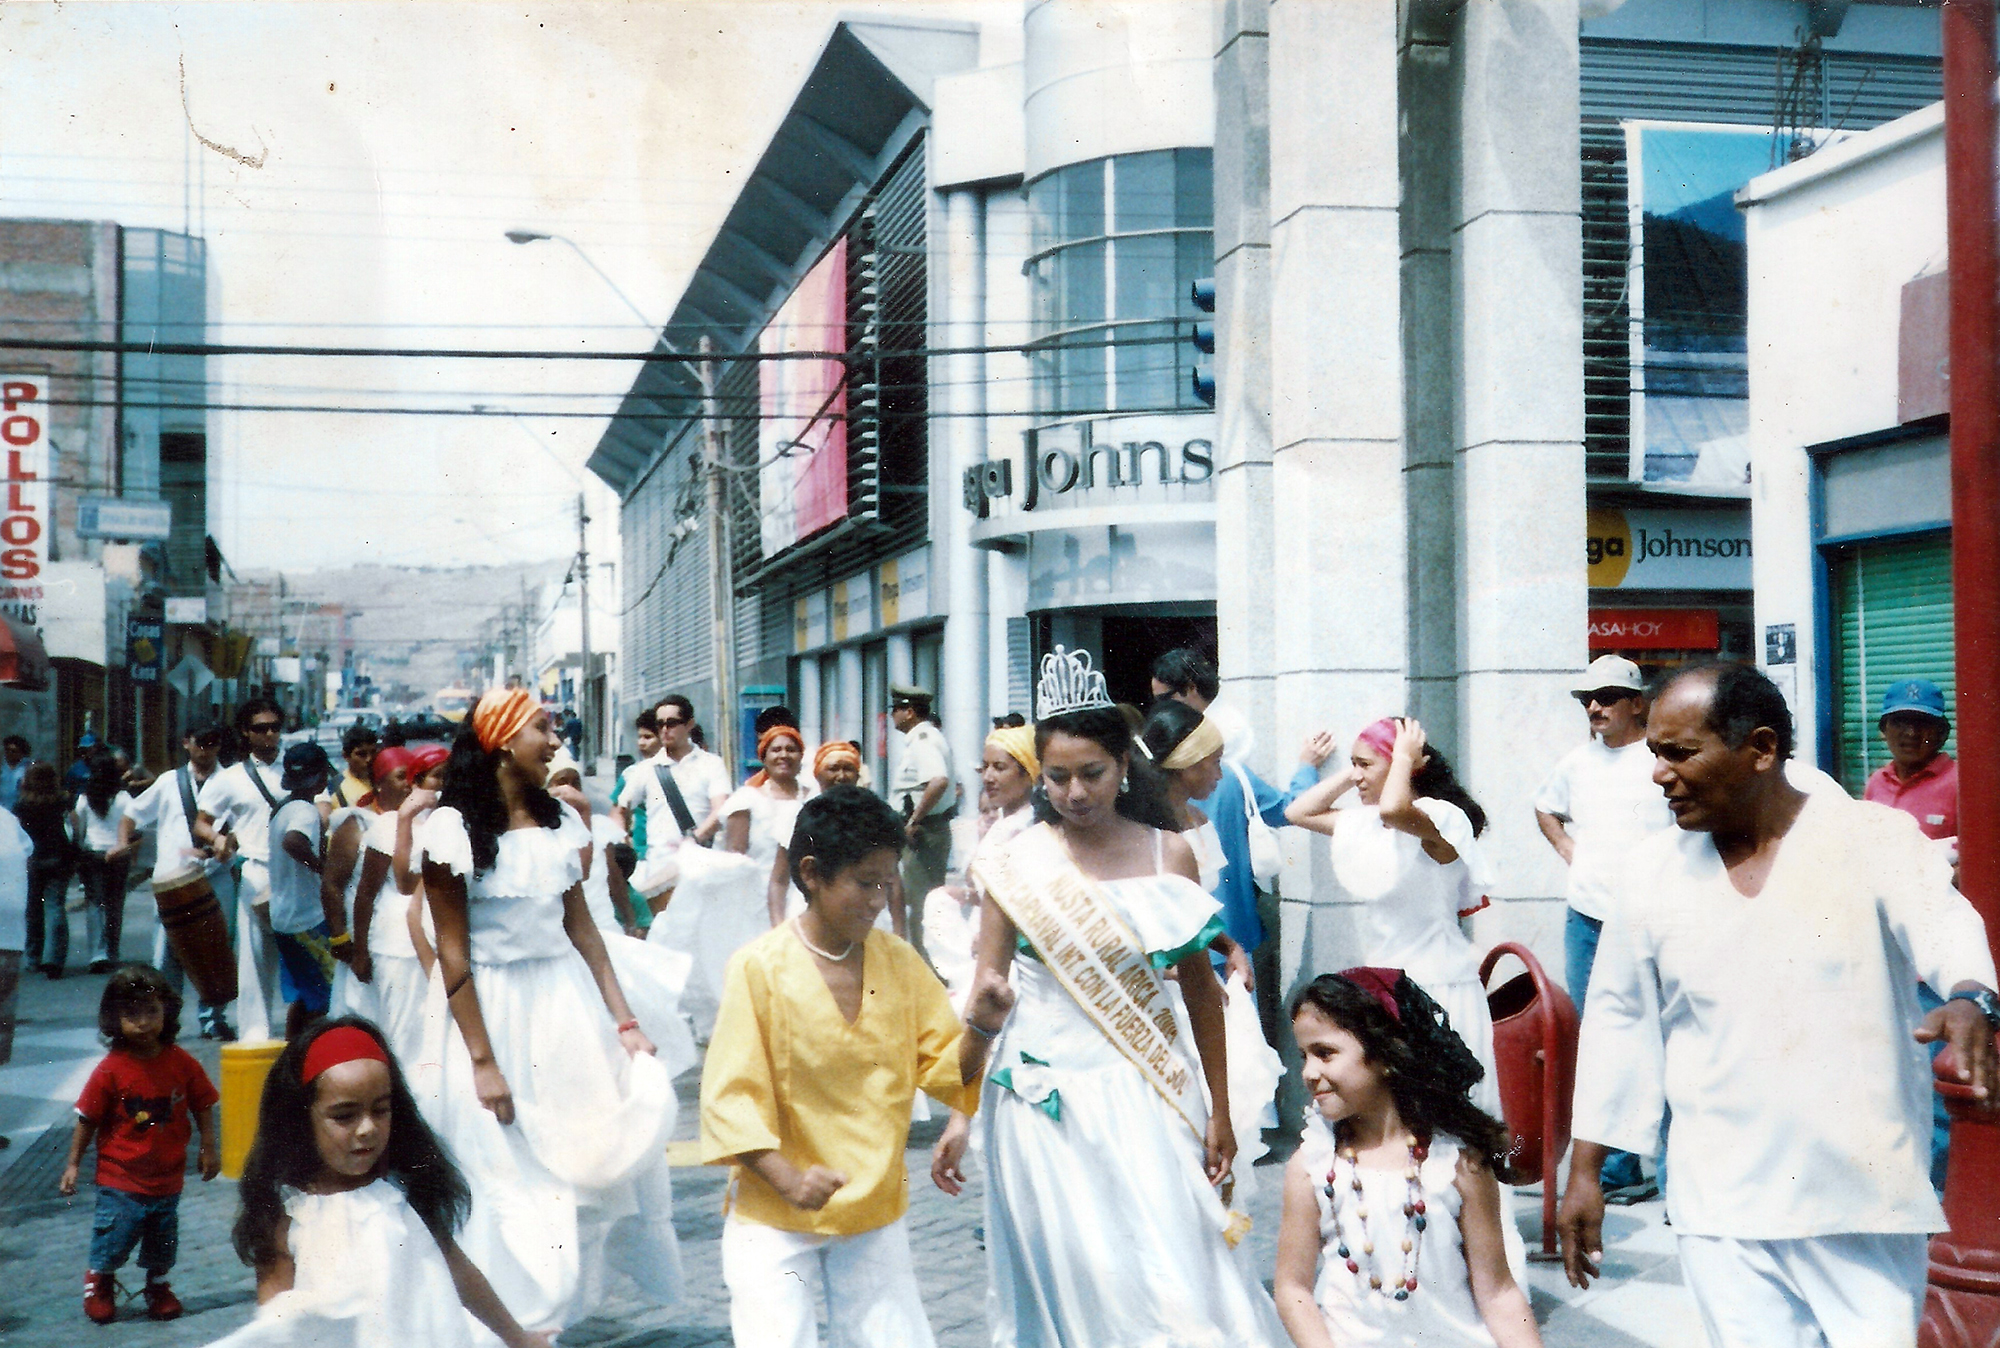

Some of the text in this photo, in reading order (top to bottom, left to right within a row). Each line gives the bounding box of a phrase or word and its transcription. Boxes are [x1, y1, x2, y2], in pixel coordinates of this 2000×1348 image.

[1, 382, 41, 580] POLLOS
[1020, 420, 1214, 512] Johns
[1637, 528, 1753, 564] Johnson
[1008, 883, 1068, 953] CARNAVAL
[1074, 965, 1108, 1000] CON
[1094, 989, 1122, 1016] LA
[1109, 1003, 1155, 1057] FUERZA
[1146, 1043, 1171, 1077] DEL
[1083, 916, 1132, 974] RURAL
[1116, 963, 1160, 1010] ARICA
